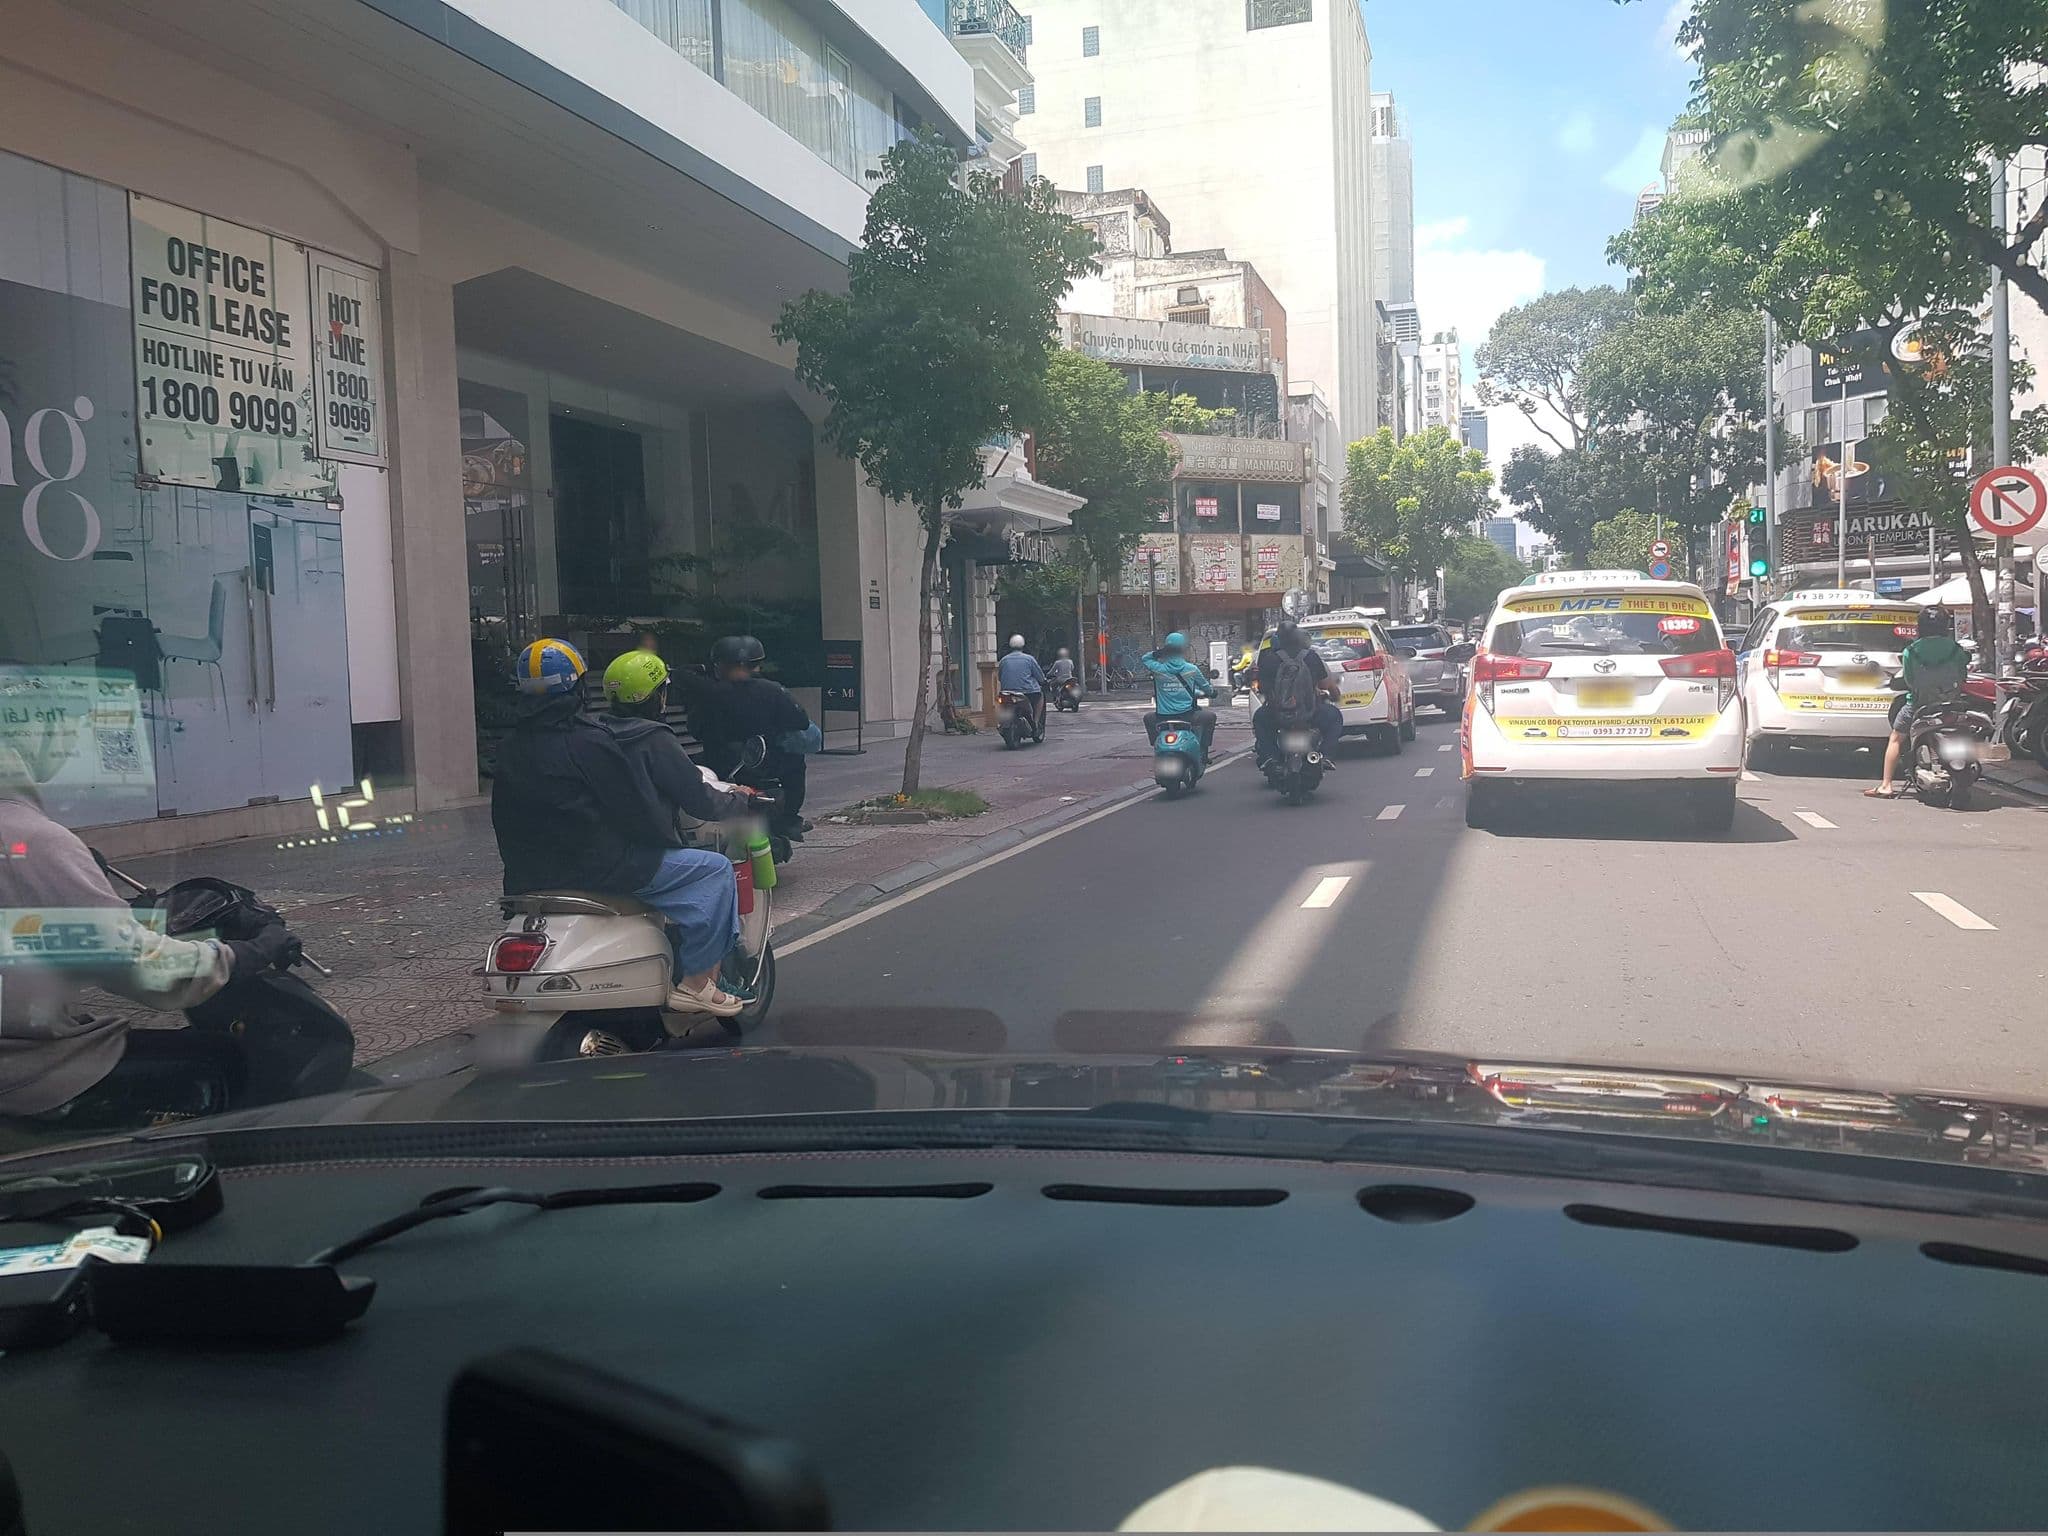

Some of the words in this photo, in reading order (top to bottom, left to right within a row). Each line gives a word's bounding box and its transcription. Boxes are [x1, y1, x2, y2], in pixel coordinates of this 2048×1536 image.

[167, 237, 266, 298] OFFICE
[141, 277, 200, 327] FOR
[210, 294, 291, 348] LEASE
[327, 292, 362, 328] HOT
[328, 334, 366, 366] LINE
[1082, 330, 1125, 352] Chuyên
[1127, 334, 1154, 356] phục
[1156, 340, 1169, 357] vụ
[1172, 338, 1189, 354] các
[1190, 340, 1214, 356] món
[1217, 342, 1230, 357] ăn
[143, 338, 224, 379] HOTLINE
[230, 357, 254, 385] TƯ
[259, 360, 294, 393] VẤN
[327, 370, 369, 401] 1800
[142, 376, 219, 426] 1800
[230, 392, 298, 439] 9099
[328, 402, 371, 433] 9099
[1244, 457, 1294, 472] MANMARU
[1874, 530, 1924, 544] TEMPURA
[1537, 603, 1555, 612] LED
[1559, 597, 1623, 612] MPE
[1827, 612, 1873, 621] MPE
